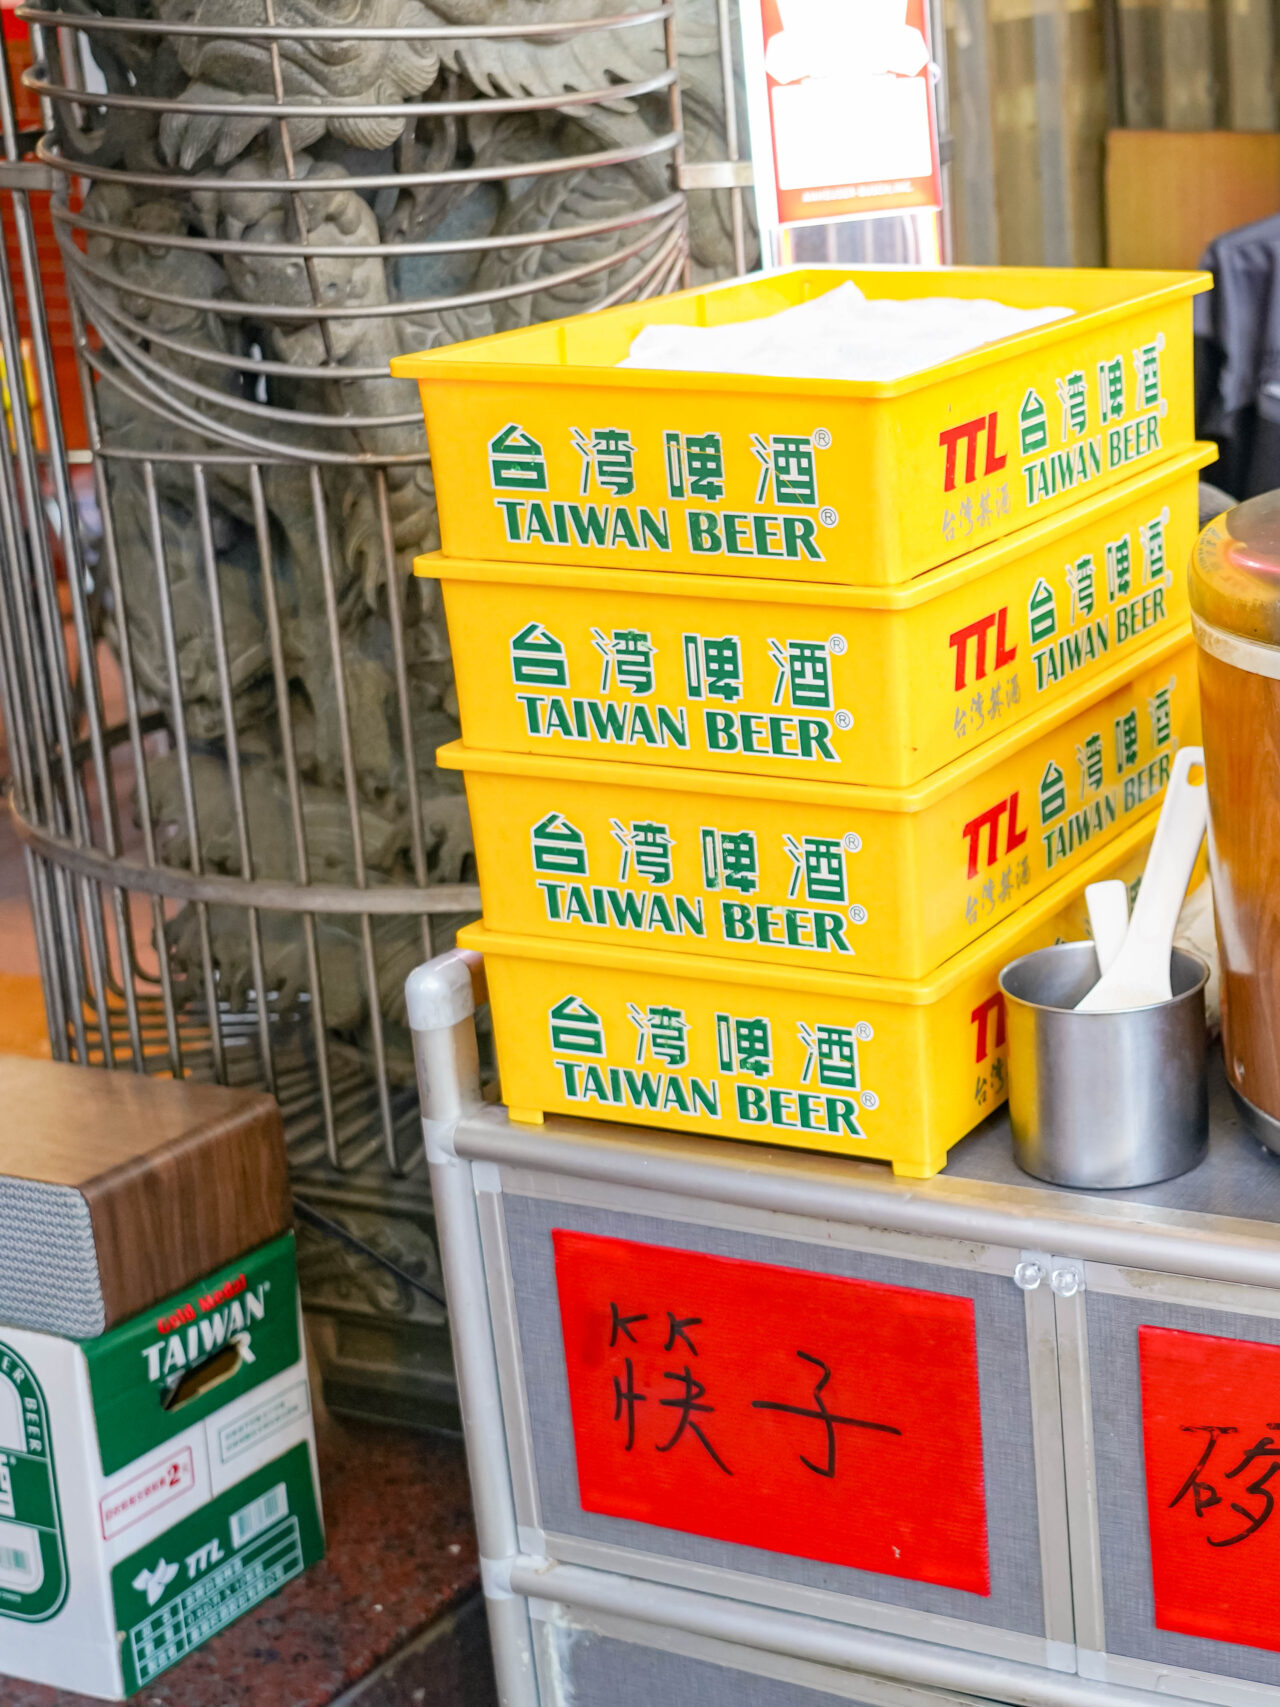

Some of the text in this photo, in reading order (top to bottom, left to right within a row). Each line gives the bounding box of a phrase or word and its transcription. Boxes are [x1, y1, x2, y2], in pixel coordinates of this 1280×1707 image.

[488, 422, 819, 508] 台湾啤酒
[939, 411, 1008, 493] TTL
[1022, 412, 1163, 507] TAIWAN BEER
[494, 498, 826, 562] TAIWAN BEER
[510, 622, 835, 711] 台湾啤酒
[949, 606, 1018, 693] TTL
[1032, 584, 1167, 692] TAIWAN BEER
[515, 692, 842, 763] TAIWAN BEER
[962, 790, 1029, 881] TTL
[1042, 753, 1171, 870] TAIWAN BEER
[530, 811, 849, 905] 台湾啤酒
[535, 879, 856, 956] TAIWAN BEER
[548, 993, 861, 1091] 台湾啤酒
[971, 990, 1007, 1064] TT
[553, 1059, 868, 1139] TAIWAN BEER
[141, 1282, 267, 1383] TAIWAN
[157, 1273, 248, 1334] Gold Medal
[24, 1396, 43, 1453] BEER
[608, 1300, 903, 1480] 筷子
[184, 1537, 226, 1580] TTL
